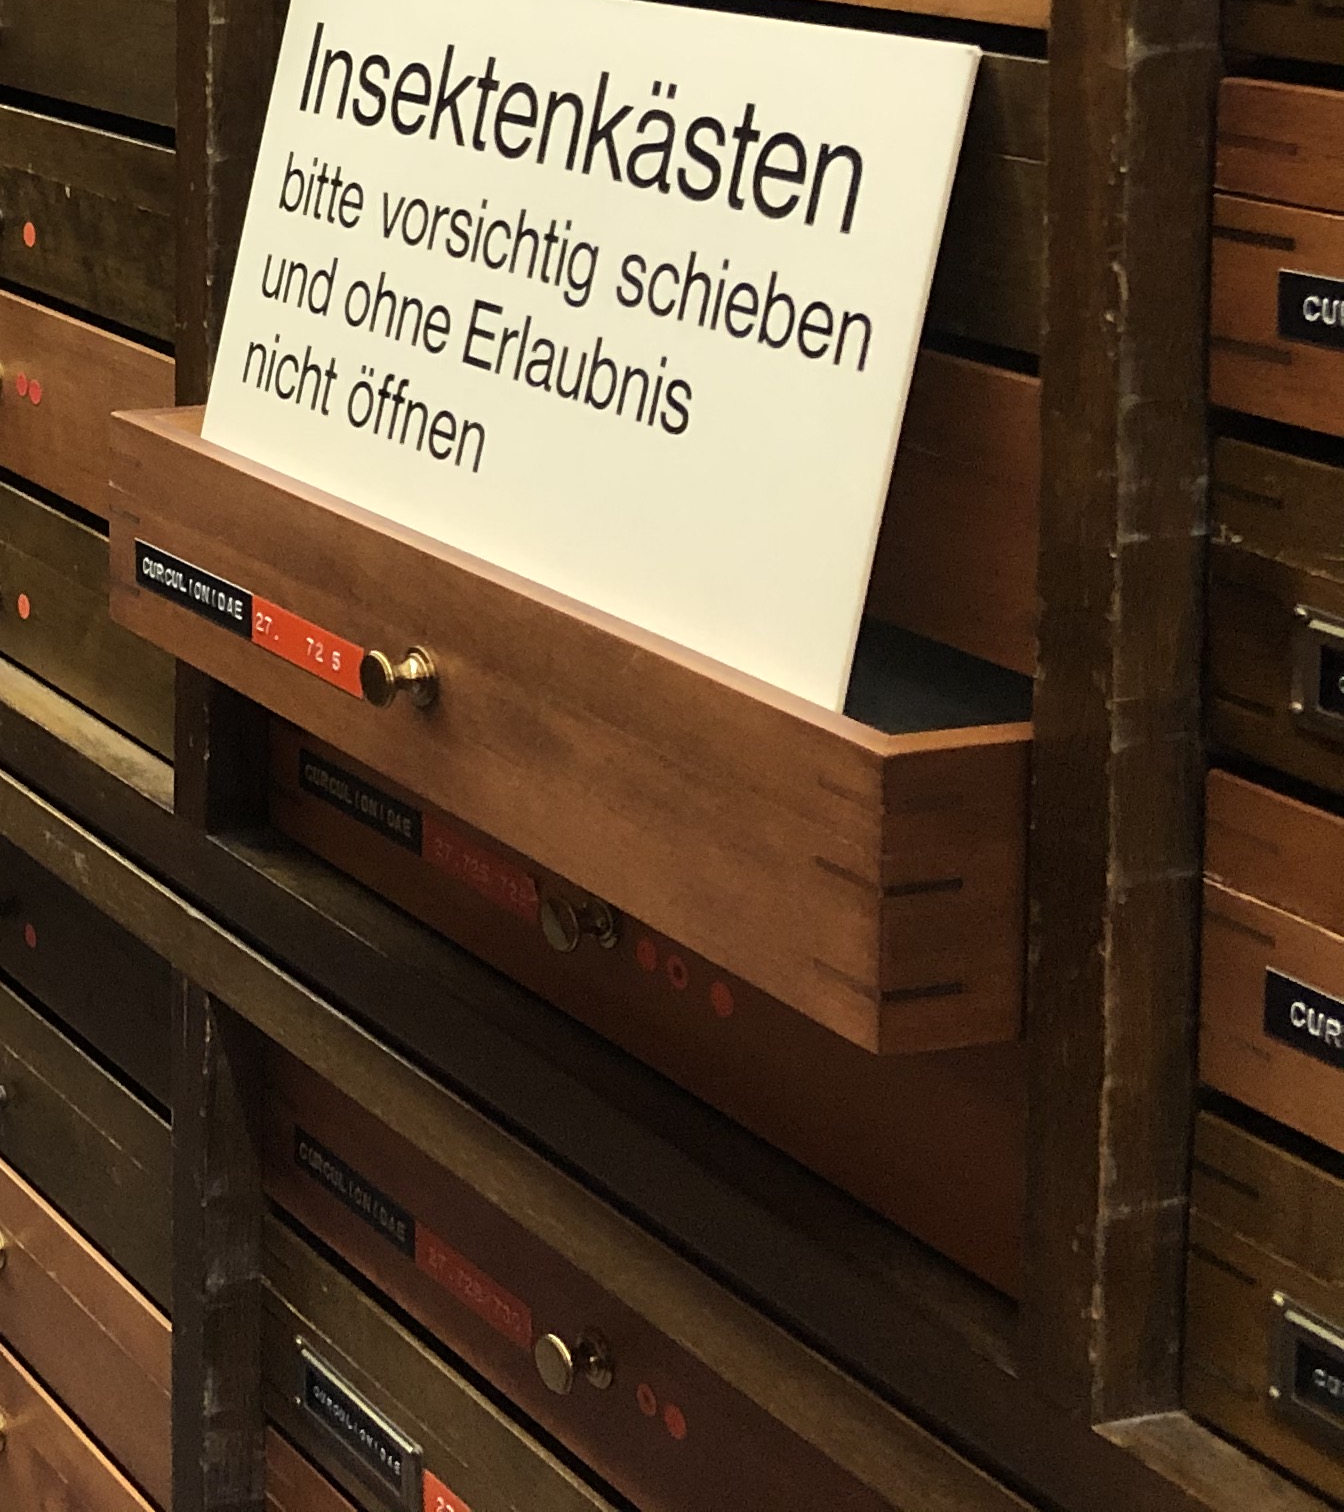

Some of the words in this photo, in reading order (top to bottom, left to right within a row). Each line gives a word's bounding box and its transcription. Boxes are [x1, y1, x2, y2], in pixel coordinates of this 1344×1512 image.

[299, 21, 863, 234] Insektenkästen
[261, 253, 339, 316] und
[344, 271, 451, 355] ohne
[462, 299, 693, 436] Erlaubnis
[278, 151, 364, 229] bitte
[382, 191, 600, 308] vorsichtig
[616, 251, 873, 372] schieben
[242, 333, 338, 416] nicht
[347, 363, 486, 474] öffnen
[141, 555, 243, 622] CURCULIONIDAE
